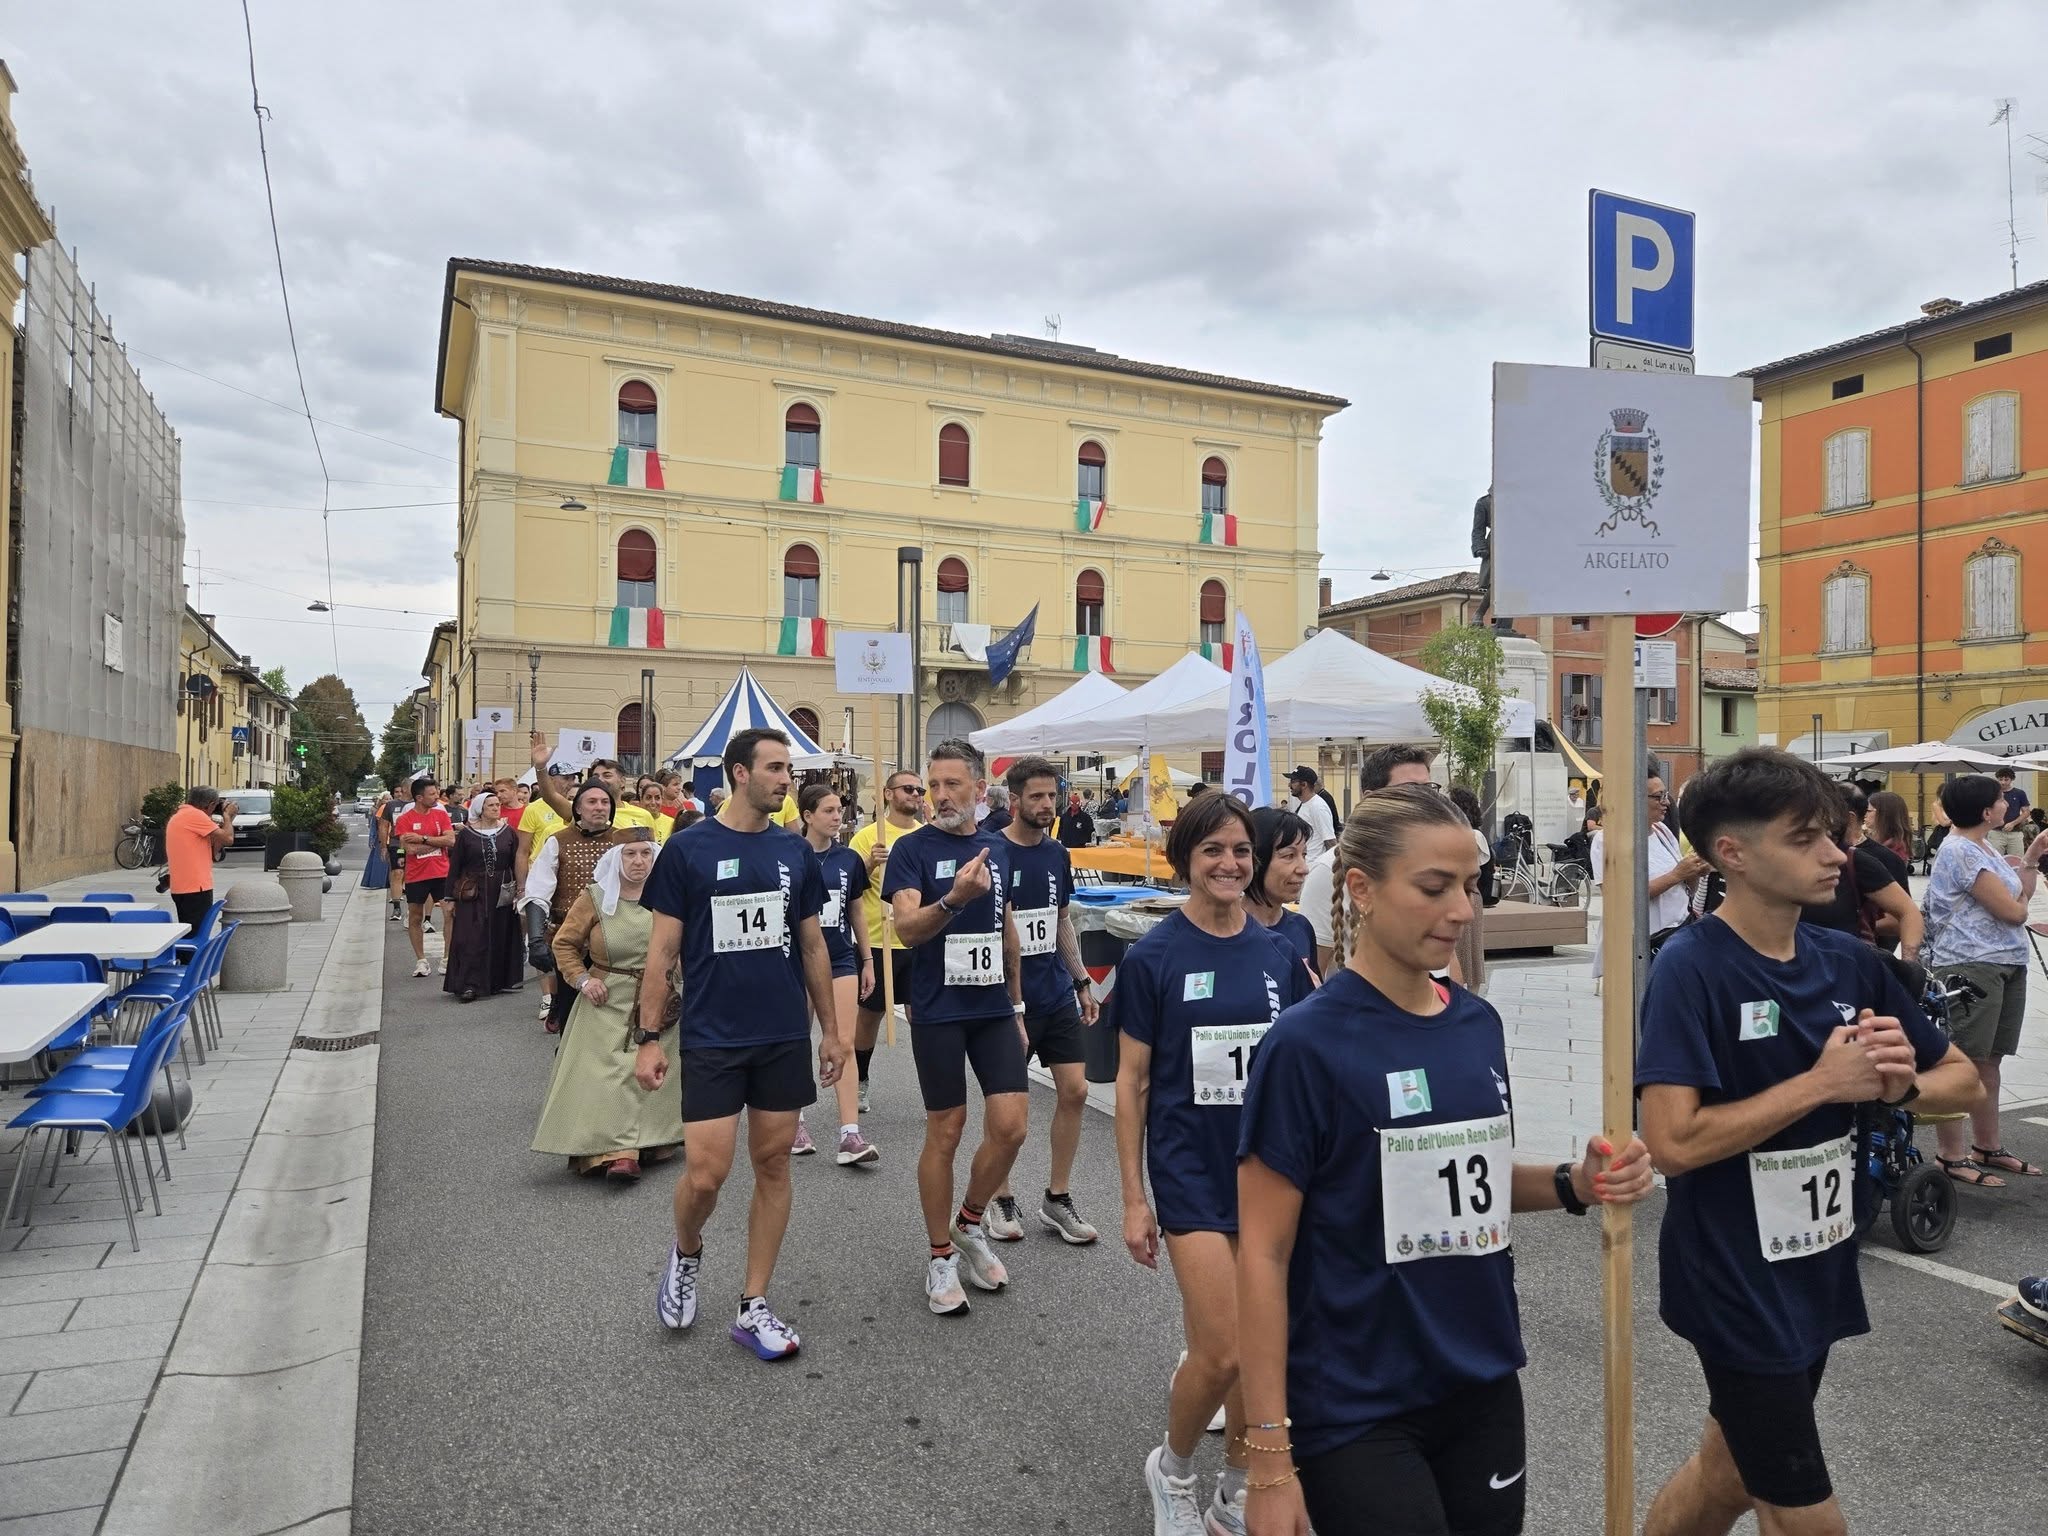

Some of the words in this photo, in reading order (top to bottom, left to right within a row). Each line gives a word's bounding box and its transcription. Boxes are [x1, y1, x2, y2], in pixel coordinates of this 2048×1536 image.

[1616, 210, 1675, 325] P
[1643, 357, 1653, 366] dal
[1655, 359, 1667, 369] Lun
[1669, 361, 1676, 370] al
[1678, 363, 1690, 373] Ven
[1583, 552, 1669, 569] ARGELATO
[988, 858, 1003, 932] ARGELA
[737, 907, 768, 934] 14
[1026, 919, 1046, 941] 16
[968, 946, 992, 970] 18
[1195, 1030, 1212, 1041] Palio
[1213, 1029, 1250, 1041] dell'Unione
[1387, 1135, 1415, 1153] Palio
[1417, 1131, 1465, 1151] dell'Unione
[1466, 1128, 1488, 1145] Reno
[1755, 1157, 1779, 1172] Palio
[1782, 1153, 1825, 1170] dell'Unione
[1438, 1154, 1493, 1217] 13
[1801, 1168, 1842, 1221] 12
